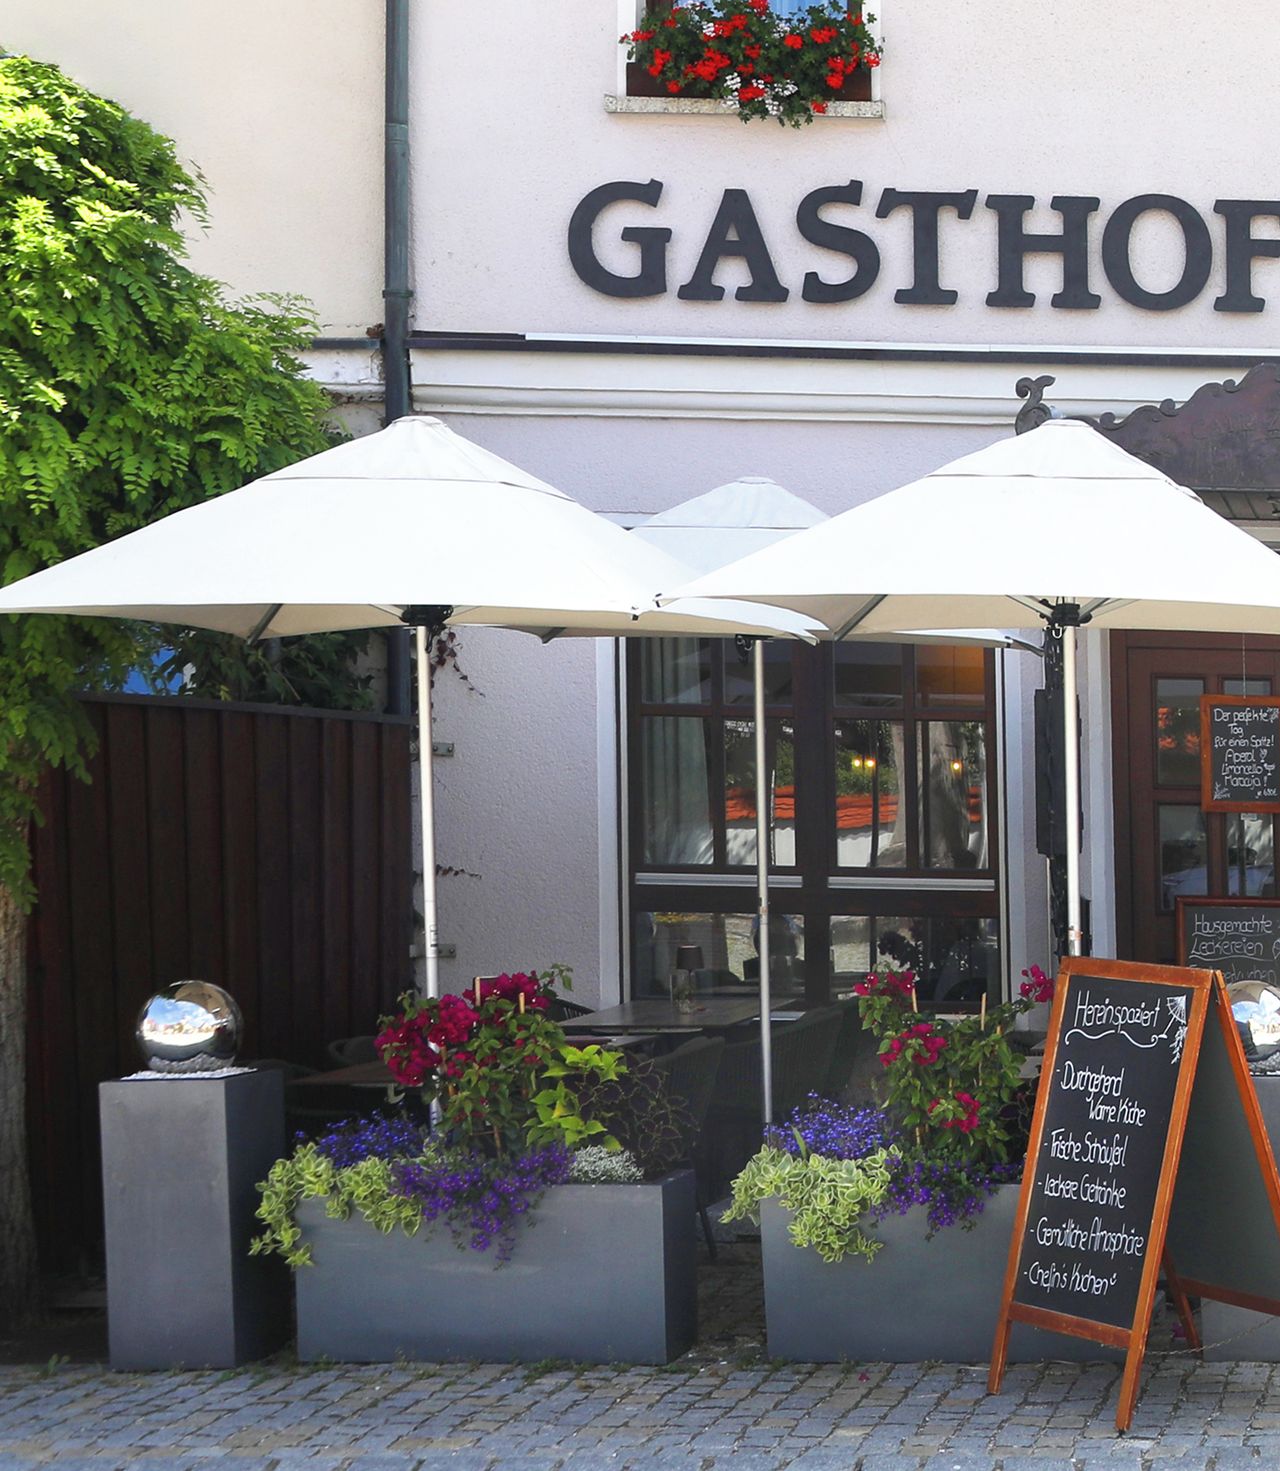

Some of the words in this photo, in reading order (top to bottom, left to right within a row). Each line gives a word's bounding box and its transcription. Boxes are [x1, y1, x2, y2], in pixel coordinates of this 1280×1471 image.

[1214, 708, 1231, 722] Der
[1233, 707, 1268, 725] perfekte
[1228, 722, 1244, 738] Tag
[1214, 735, 1227, 748] für
[1228, 736, 1249, 747] einen
[1225, 748, 1256, 764] Aperol
[1194, 913, 1273, 939] Hausgemachte
[1191, 937, 1264, 956] Leckereien
[1074, 990, 1161, 1033] Hereinspaziert
[1061, 1060, 1125, 1102] Durchgehend
[1116, 1097, 1146, 1126] Küche
[1051, 1128, 1082, 1162] Frische
[1044, 1173, 1078, 1200] Leckere
[1080, 1174, 1126, 1208] Getränke
[1036, 1216, 1089, 1251] Gemütliche
[1087, 1216, 1145, 1260] Atmosphäre
[1069, 1263, 1109, 1295] Kuchen
